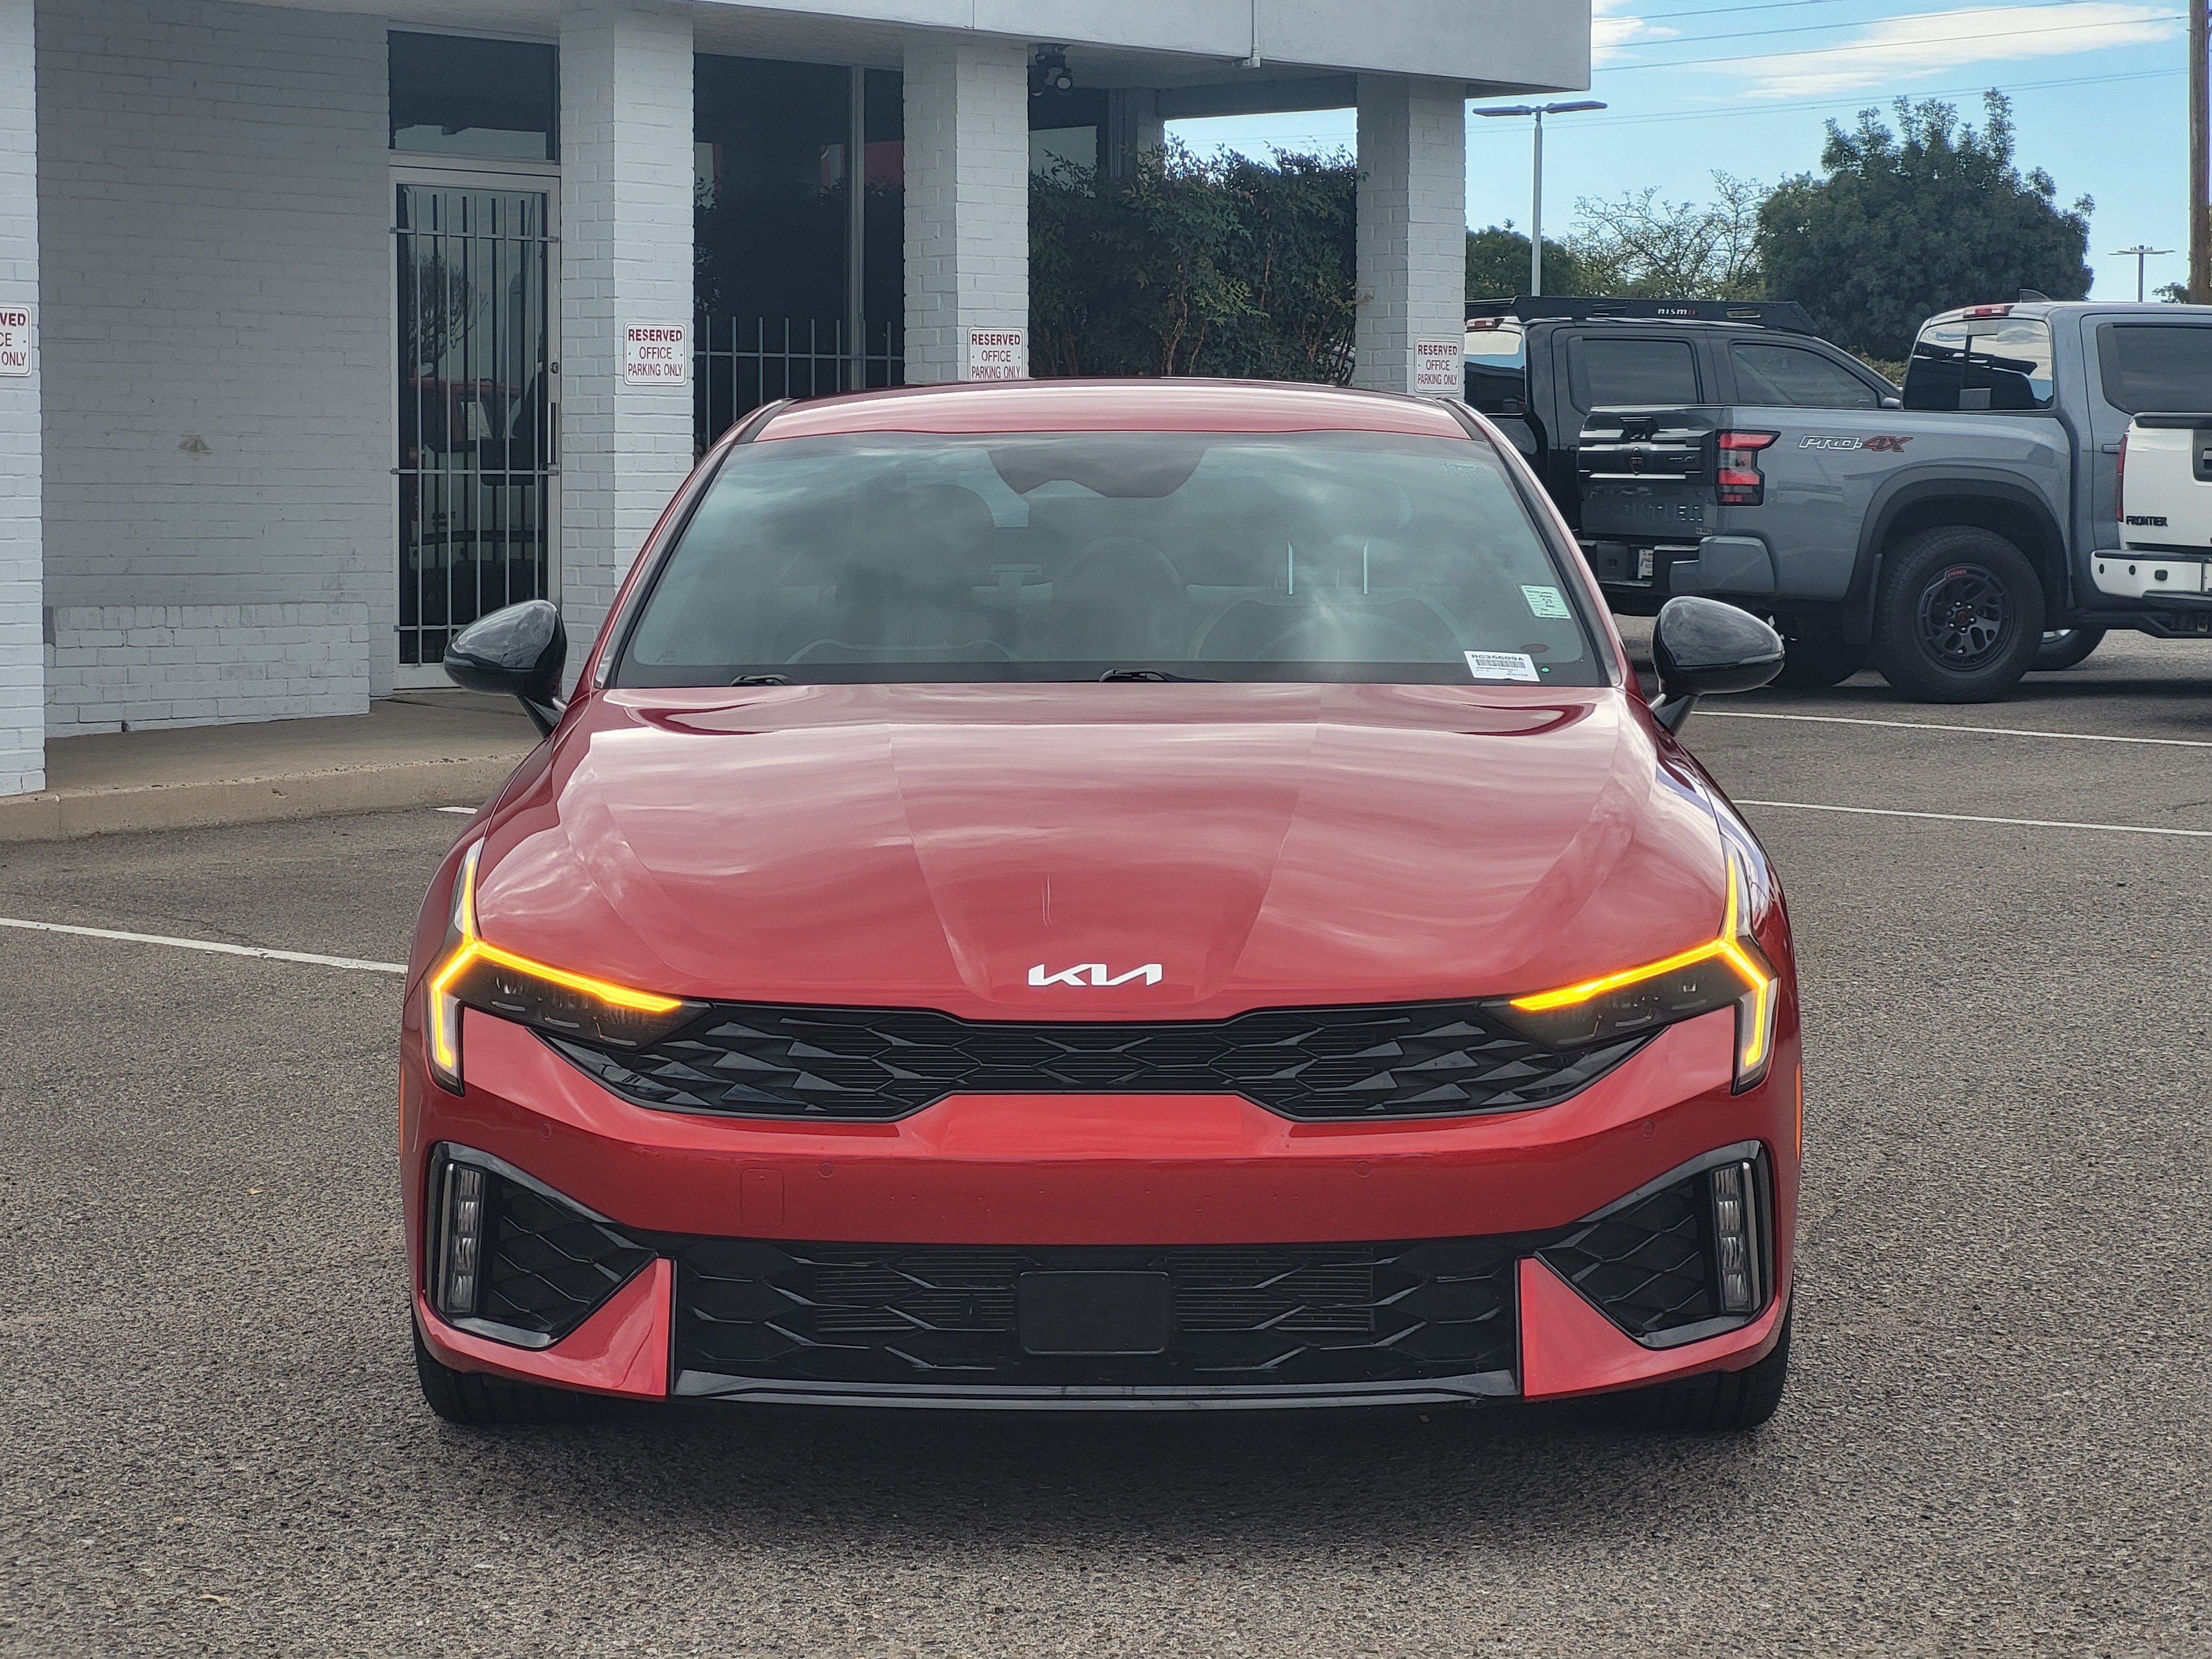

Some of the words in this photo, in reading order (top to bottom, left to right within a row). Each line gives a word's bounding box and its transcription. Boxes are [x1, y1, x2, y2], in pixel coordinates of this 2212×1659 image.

[628, 329, 682, 342] RESERVED
[972, 333, 1020, 346] RESERVED
[639, 346, 672, 359] OFFICE
[982, 350, 1011, 362] OFFICE
[1418, 345, 1457, 356] RESERVED
[2, 351, 26, 366] ONLY
[1426, 359, 1450, 371] OFFICE
[628, 363, 661, 376] PARKING
[664, 363, 683, 377] ONLY
[972, 366, 1001, 379] PARKING
[1004, 366, 1020, 378] ONLY
[1418, 373, 1442, 385] PARKING
[1444, 374, 1458, 385] ONLY
[1799, 435, 1913, 452] PRO-4X
[2126, 515, 2168, 526] FRONTIER
[1028, 963, 1162, 986] KIA
